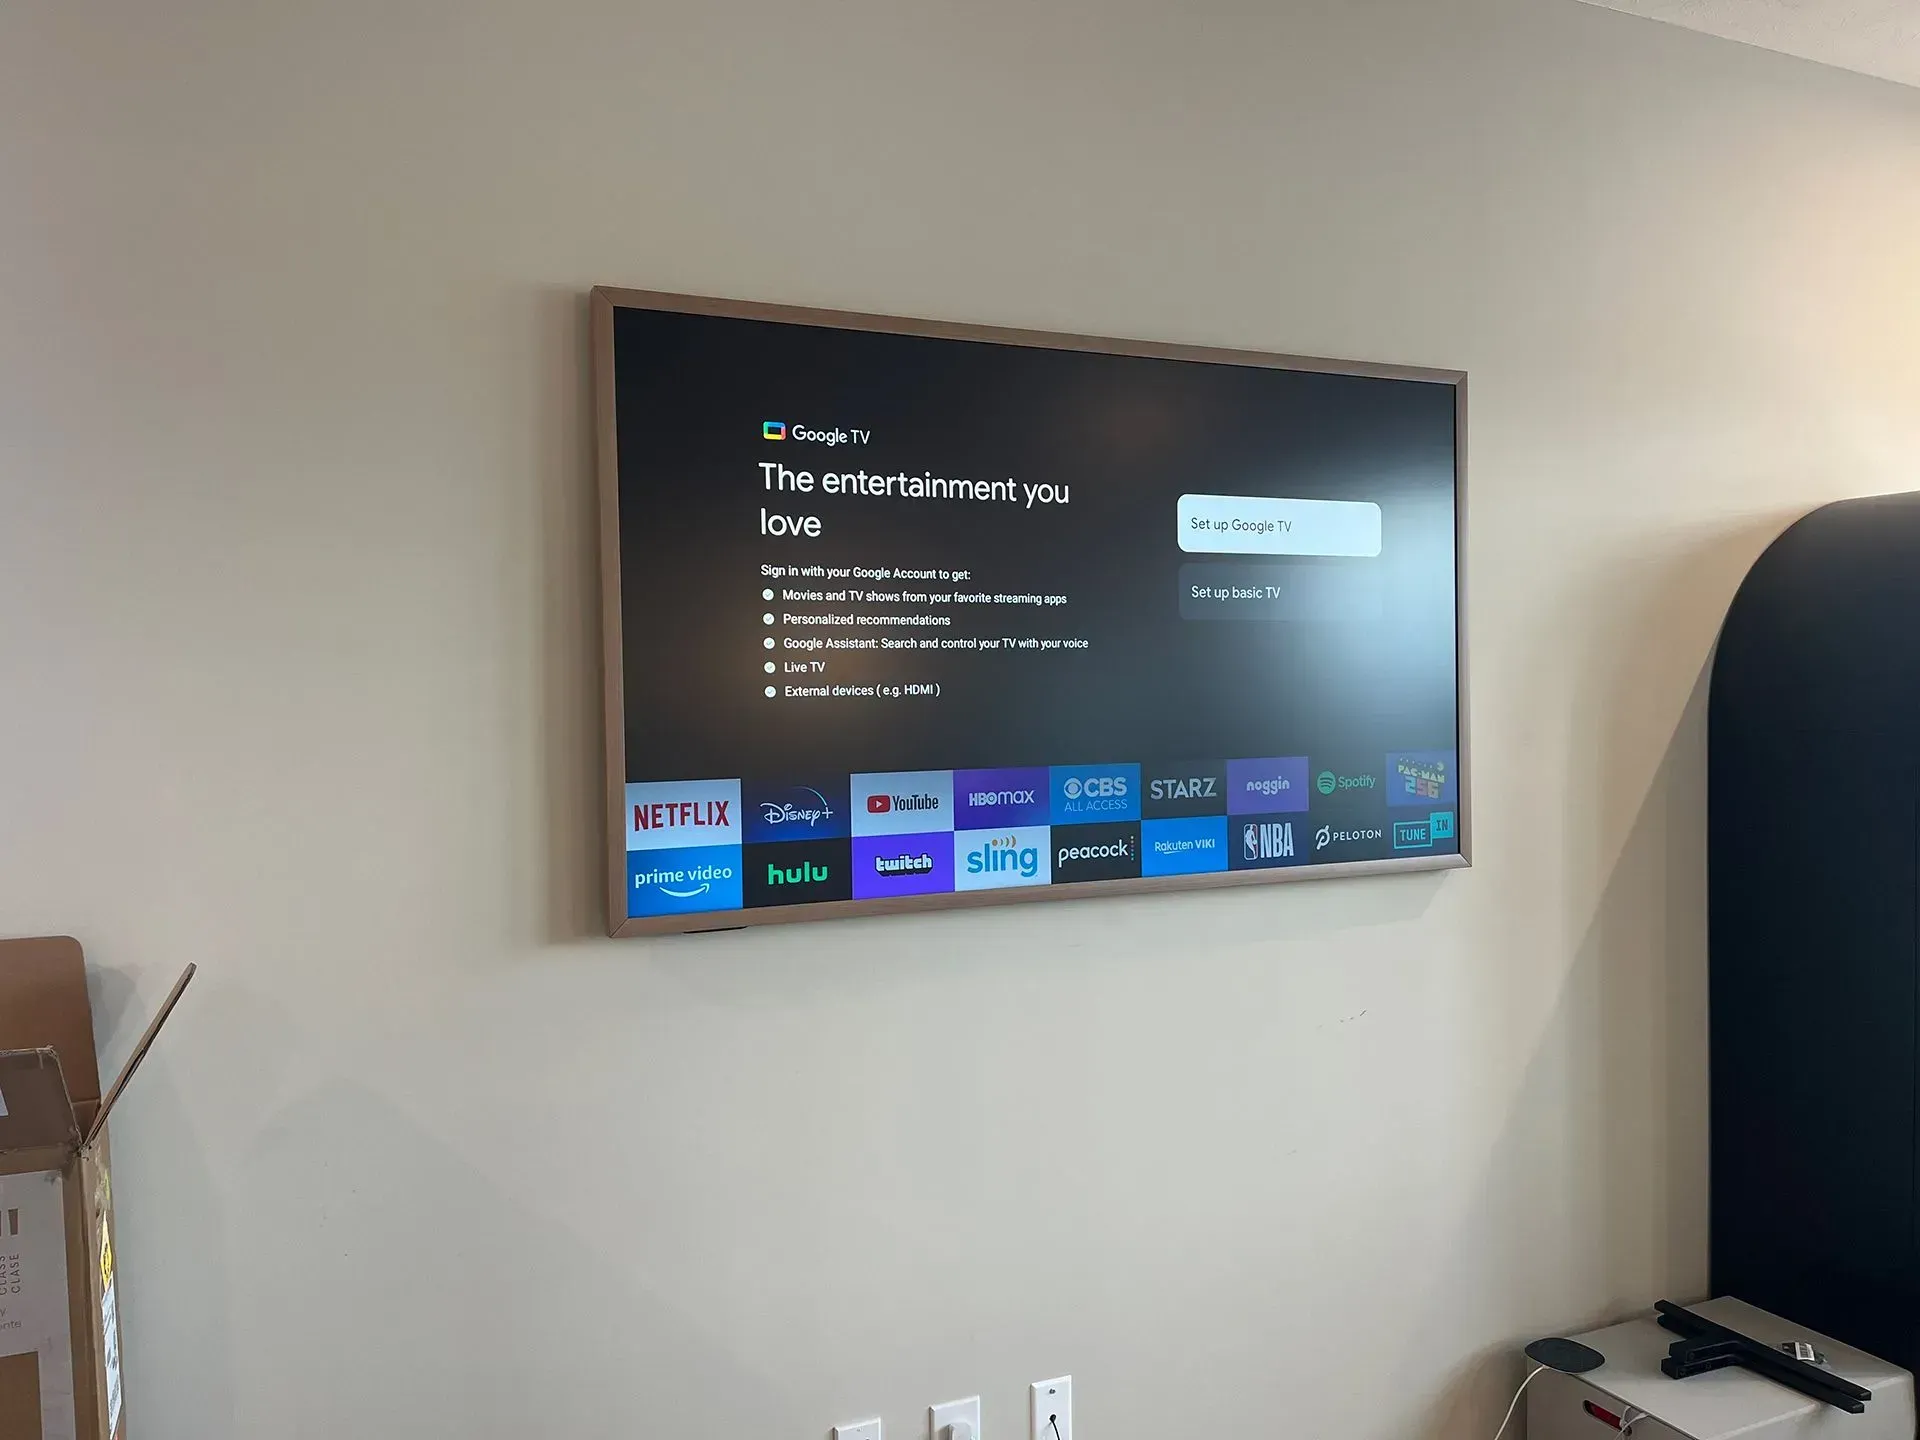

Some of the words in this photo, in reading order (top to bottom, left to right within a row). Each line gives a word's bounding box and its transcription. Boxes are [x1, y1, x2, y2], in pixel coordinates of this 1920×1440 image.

[792, 424, 848, 446] Google
[850, 429, 871, 444] TV
[758, 462, 814, 492] The
[822, 471, 1017, 501] entertainment
[1023, 482, 1069, 509] you
[760, 508, 821, 537] love
[1191, 517, 1210, 530] Set
[1214, 519, 1228, 532] up
[1232, 519, 1274, 534] Google
[1278, 520, 1292, 532] TV
[760, 564, 786, 579] Sign
[788, 565, 799, 577] in
[801, 565, 825, 577] with
[827, 568, 851, 580] your
[853, 566, 891, 581] Google
[893, 568, 937, 580] Account
[938, 569, 950, 580] to
[951, 570, 971, 582] get:
[782, 589, 824, 601] Movies
[825, 590, 846, 602] and
[848, 590, 864, 601] TV
[865, 590, 900, 602] shows
[902, 591, 928, 603] from
[929, 593, 952, 605] your
[953, 592, 992, 603] favorite
[993, 593, 1042, 606] streaming
[1044, 595, 1067, 606] apps
[1191, 585, 1211, 598] Set
[1214, 587, 1229, 600] up
[1232, 586, 1263, 599] basic
[1265, 586, 1281, 599] TV
[783, 613, 854, 625] Personalized
[856, 614, 951, 626] recommendations
[783, 637, 823, 651] Google
[825, 637, 879, 649] Assistant:
[881, 638, 917, 649] Search
[919, 638, 939, 649] and
[940, 638, 977, 649] control
[978, 639, 1000, 652] your
[1001, 638, 1016, 649] TV
[1017, 638, 1039, 649] with
[1040, 639, 1061, 651] your
[1062, 638, 1089, 649] voice
[784, 661, 808, 673] Live
[809, 661, 825, 673] TV
[784, 685, 829, 697] External
[832, 685, 874, 696] devices
[904, 684, 934, 696] HDMI
[1338, 774, 1377, 789] Spotify
[1398, 764, 1446, 784] PAC-MAN
[1084, 777, 1128, 798] CBS
[1150, 777, 1217, 800] STARZ
[1246, 776, 1290, 795] noggin
[1405, 775, 1439, 799] 256
[892, 793, 939, 811] YouTube
[1064, 801, 1083, 812] ALL
[1086, 799, 1128, 811] ACCESS
[633, 800, 730, 832] NETFLIX
[1436, 819, 1449, 831] IN
[1260, 822, 1295, 858] NBA
[1333, 829, 1383, 841] PELOTON
[1399, 828, 1427, 841] TUNE
[1058, 839, 1129, 868] peacock
[1154, 840, 1194, 855] Rakuten
[1194, 838, 1216, 849] VIKI
[875, 854, 933, 873] twitch
[966, 843, 1038, 878] sling
[635, 869, 684, 889] prime
[687, 865, 733, 881] video
[767, 861, 829, 886] hulu
[9, 1253, 21, 1294] CLASE
